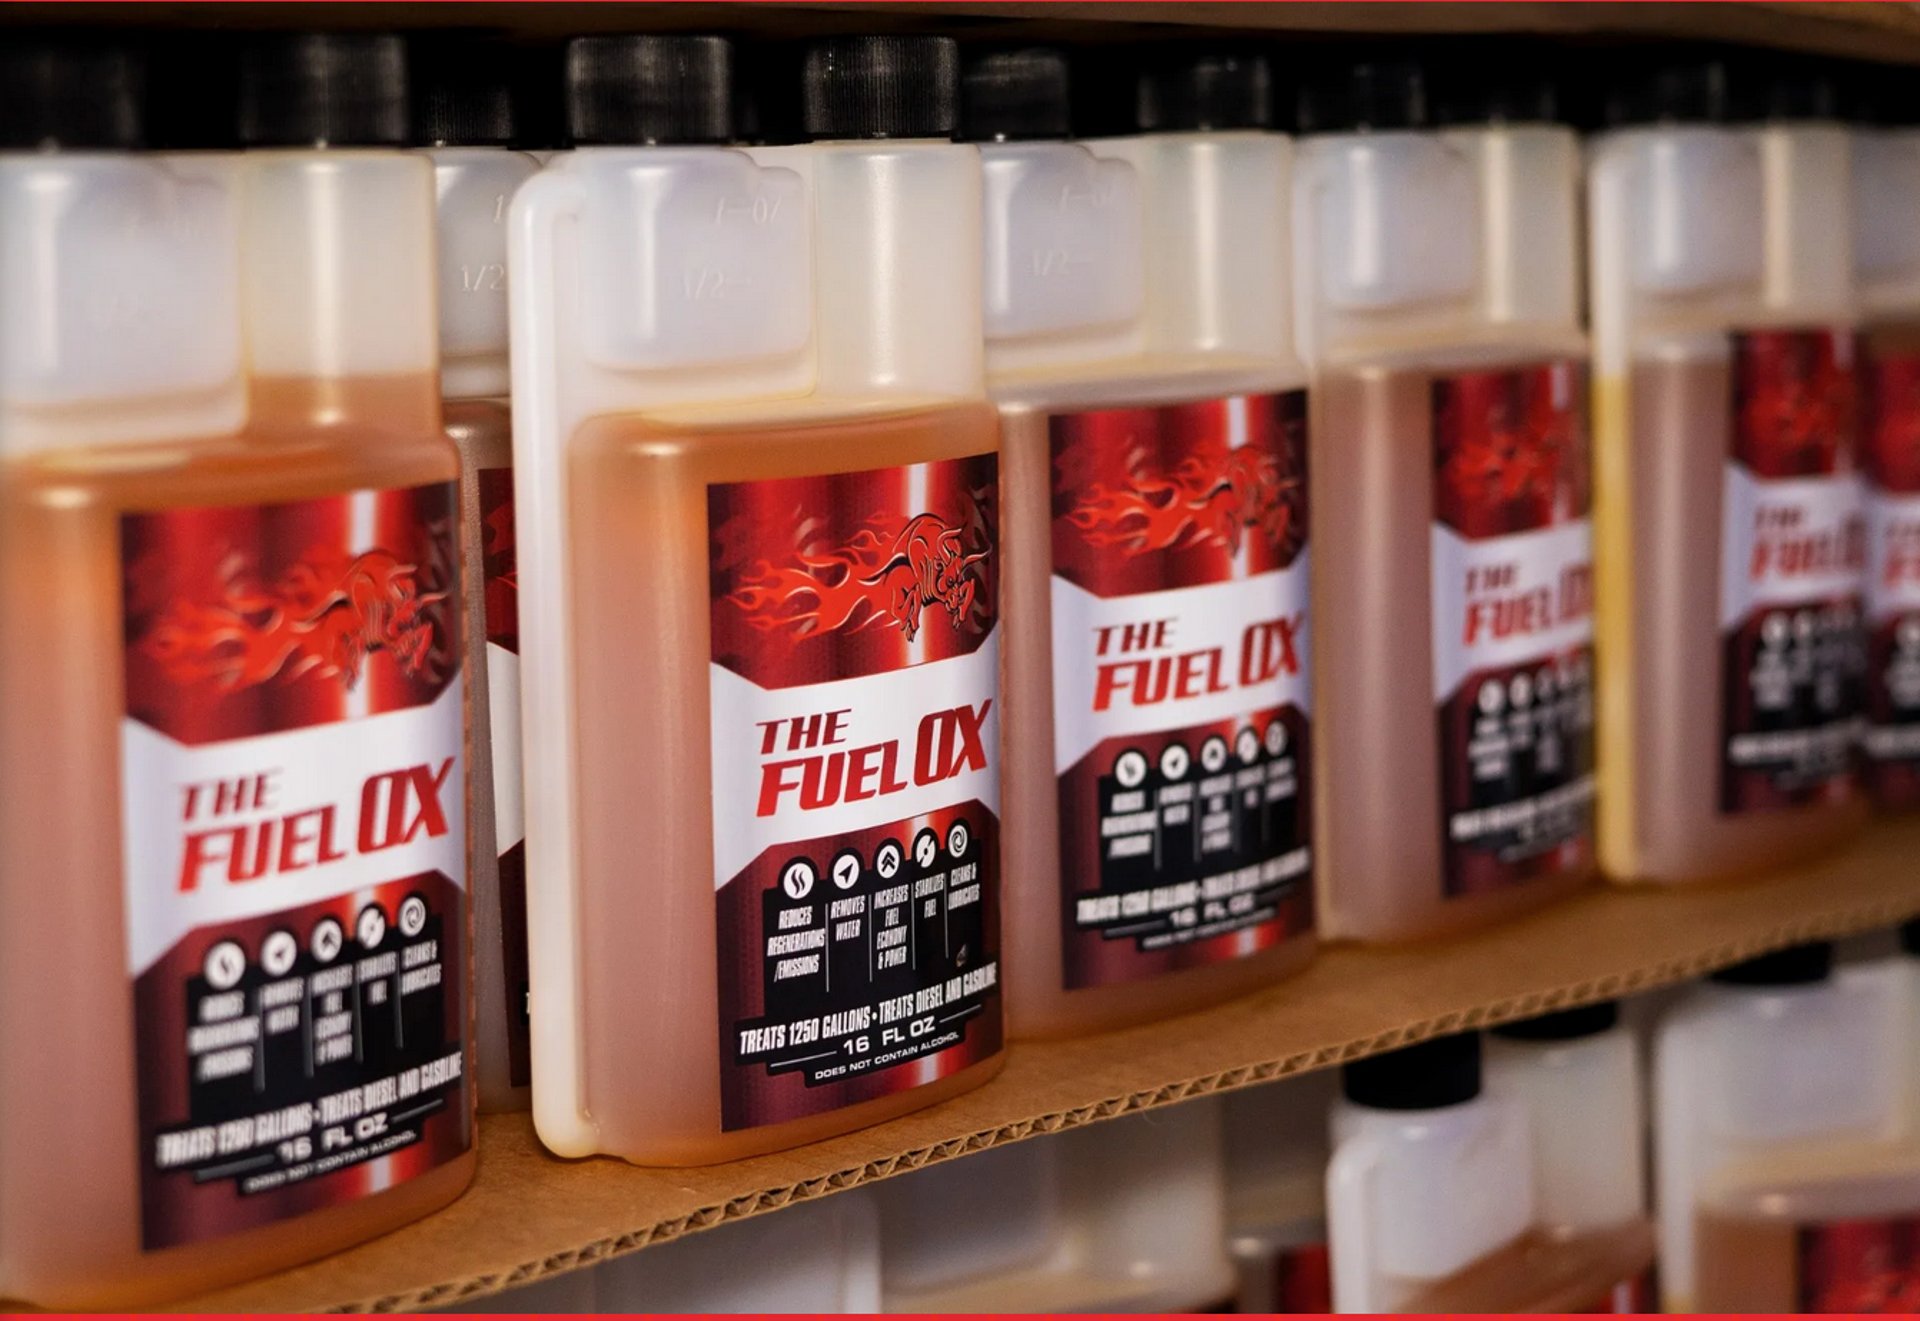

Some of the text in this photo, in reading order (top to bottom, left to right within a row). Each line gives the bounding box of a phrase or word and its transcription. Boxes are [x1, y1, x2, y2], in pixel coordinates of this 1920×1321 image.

[1092, 616, 1178, 657] THE
[1092, 608, 1305, 713] FUEL OX
[756, 708, 852, 755] THE
[757, 698, 993, 818] FUEL OX
[180, 766, 284, 822] THE
[178, 755, 456, 895] FUEL OX
[779, 906, 813, 930] REDUCES
[831, 895, 865, 919] REMOVES
[874, 884, 909, 909] INCREASES
[885, 907, 899, 928] FUEL
[767, 928, 825, 957] REGENERATIONS
[836, 919, 861, 942] WATER
[877, 925, 907, 951] ECONOMY
[740, 961, 997, 1055] TREATS 1250 GALLONS TREATS DIESEL AND GASOLINE
[815, 1031, 960, 1080] DOES NOT CONTAIN ALCOHOL
[843, 1015, 935, 1055] 16 FL OZ
[363, 1075, 397, 1112] DIESEL
[399, 1067, 420, 1101] AND
[420, 1051, 462, 1092] GASOLINE
[276, 1112, 388, 1164] 16 FL OZ
